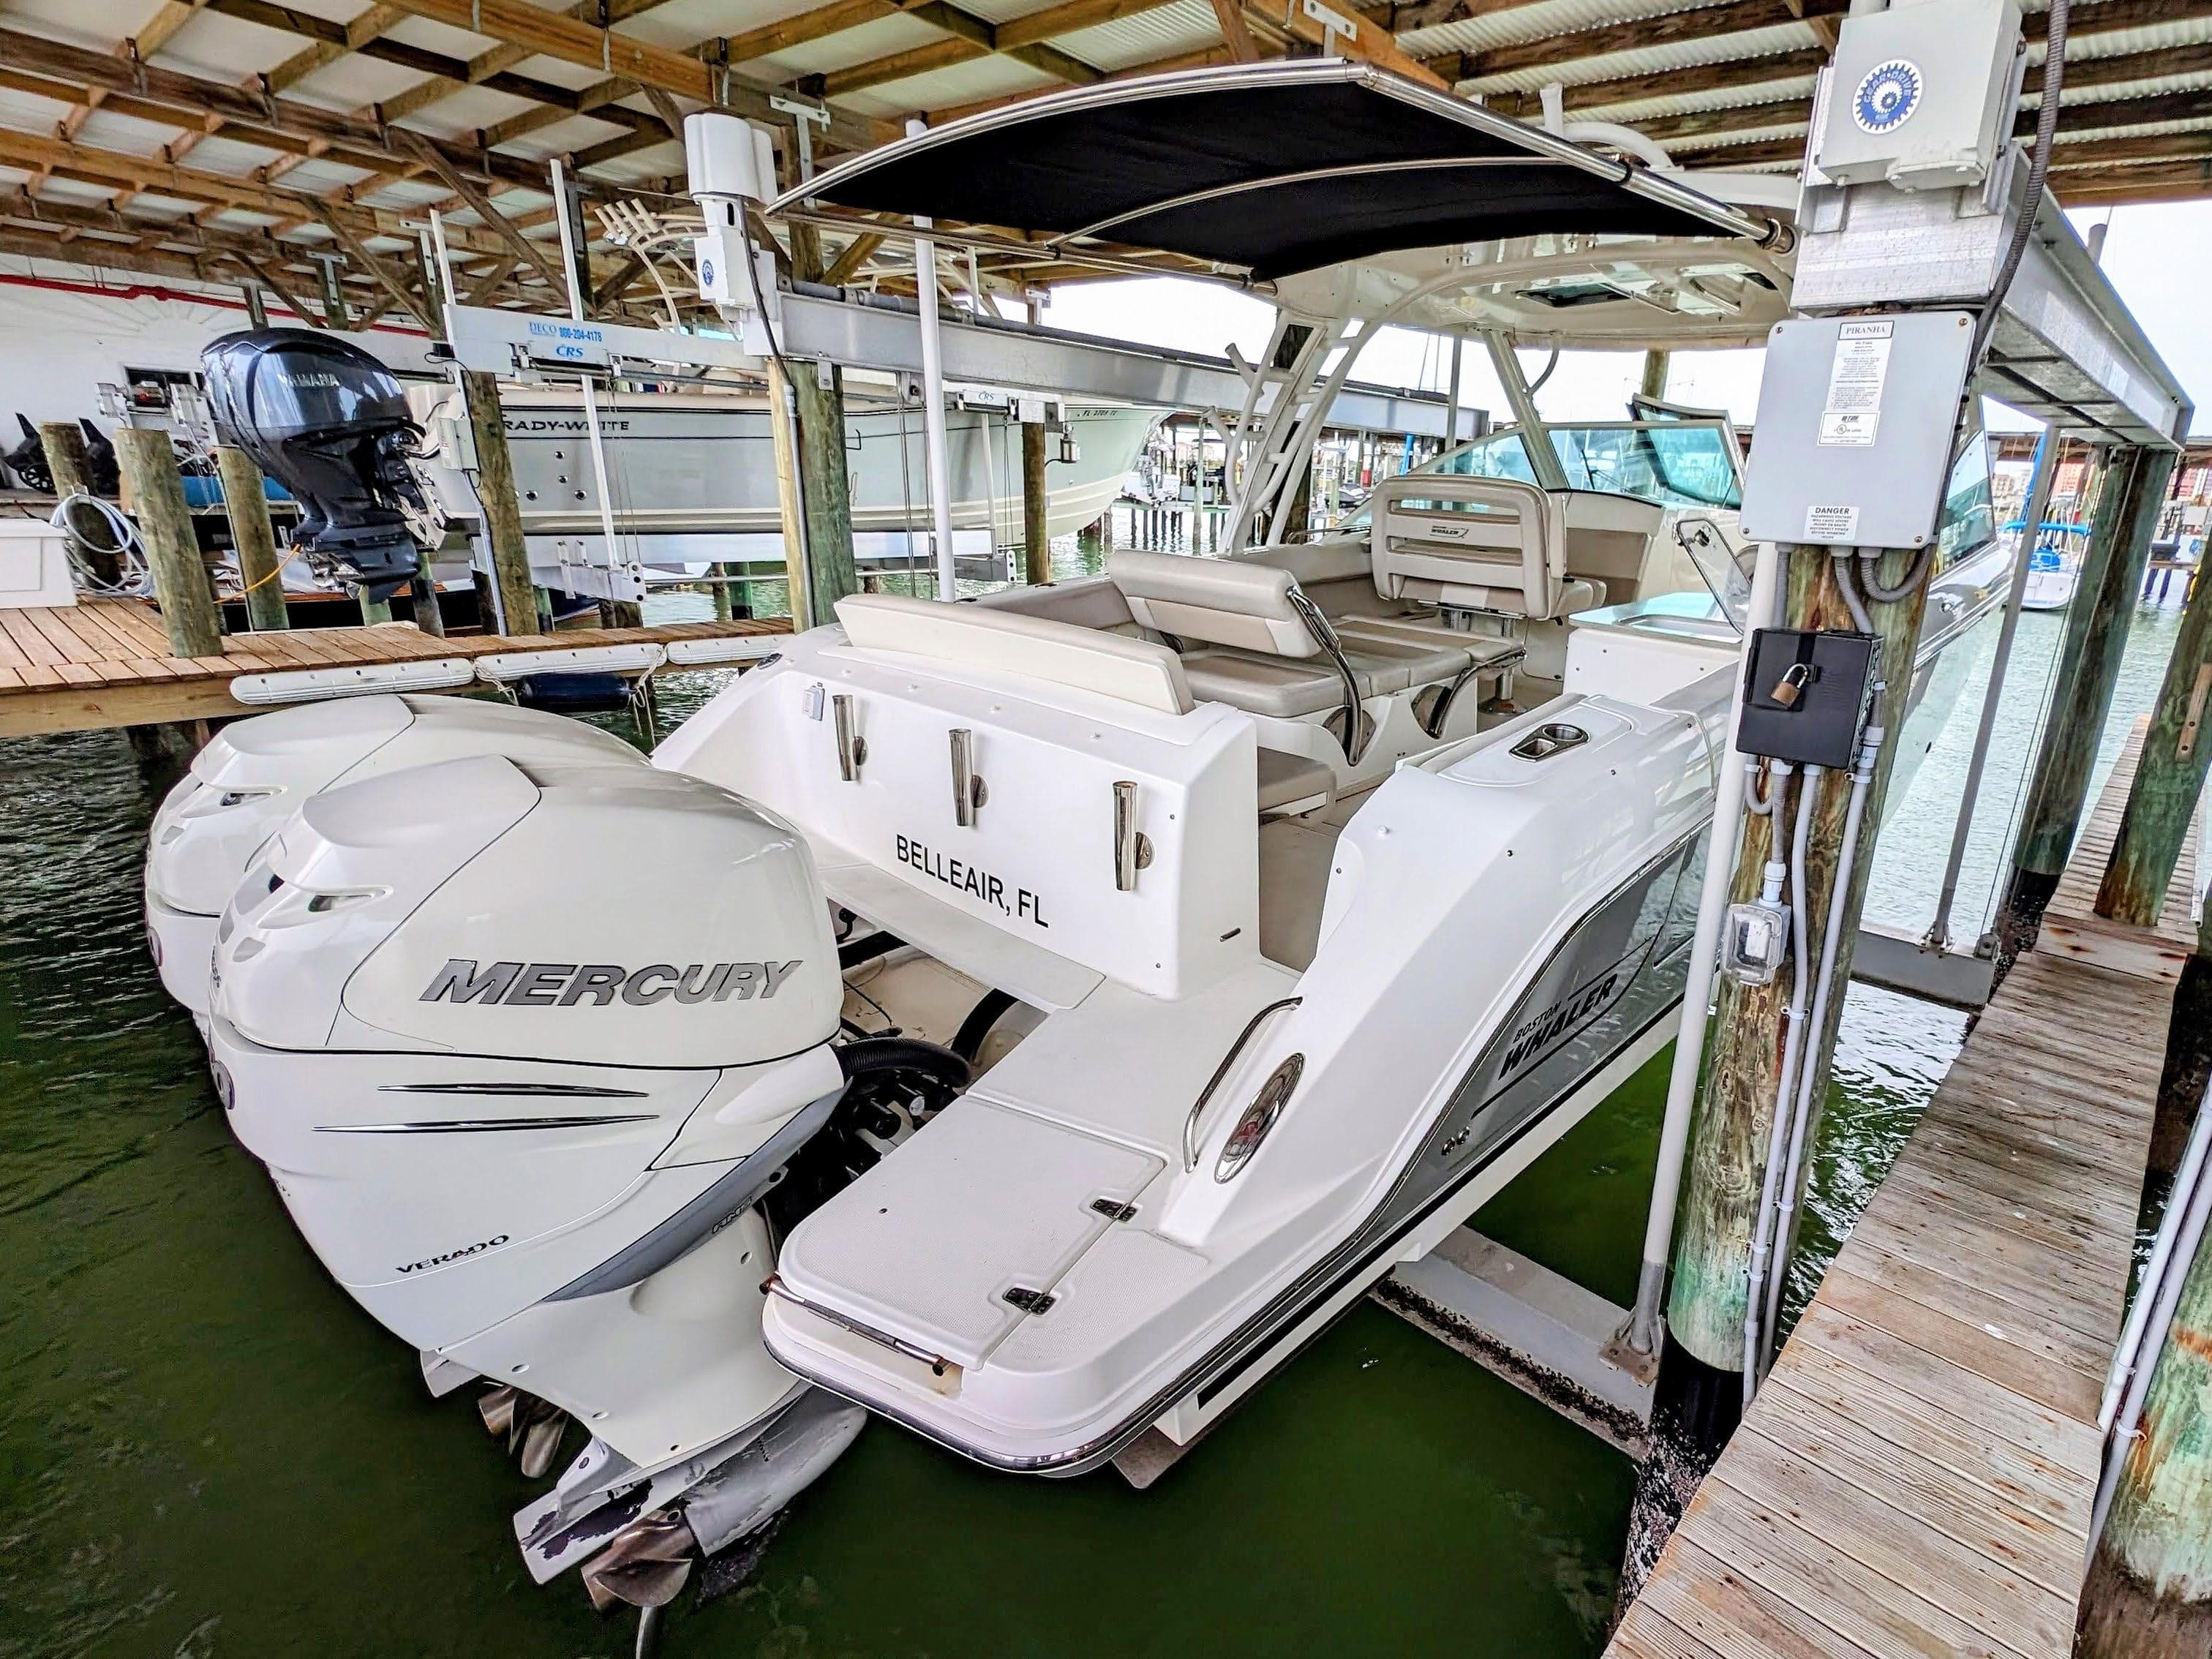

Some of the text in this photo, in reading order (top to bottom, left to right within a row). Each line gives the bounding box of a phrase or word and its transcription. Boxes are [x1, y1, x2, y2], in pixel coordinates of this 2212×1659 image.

[1846, 326, 1885, 334] PIRANHA
[556, 345, 584, 358] CRS
[501, 420, 630, 432] RADY-WITE
[896, 833, 1049, 928] BELLEAIR, FL
[418, 958, 804, 1006] MERCURY
[1498, 973, 1618, 1081] WHALER
[1513, 1001, 1562, 1044] BOSTON
[396, 1235, 509, 1273] VERADO
